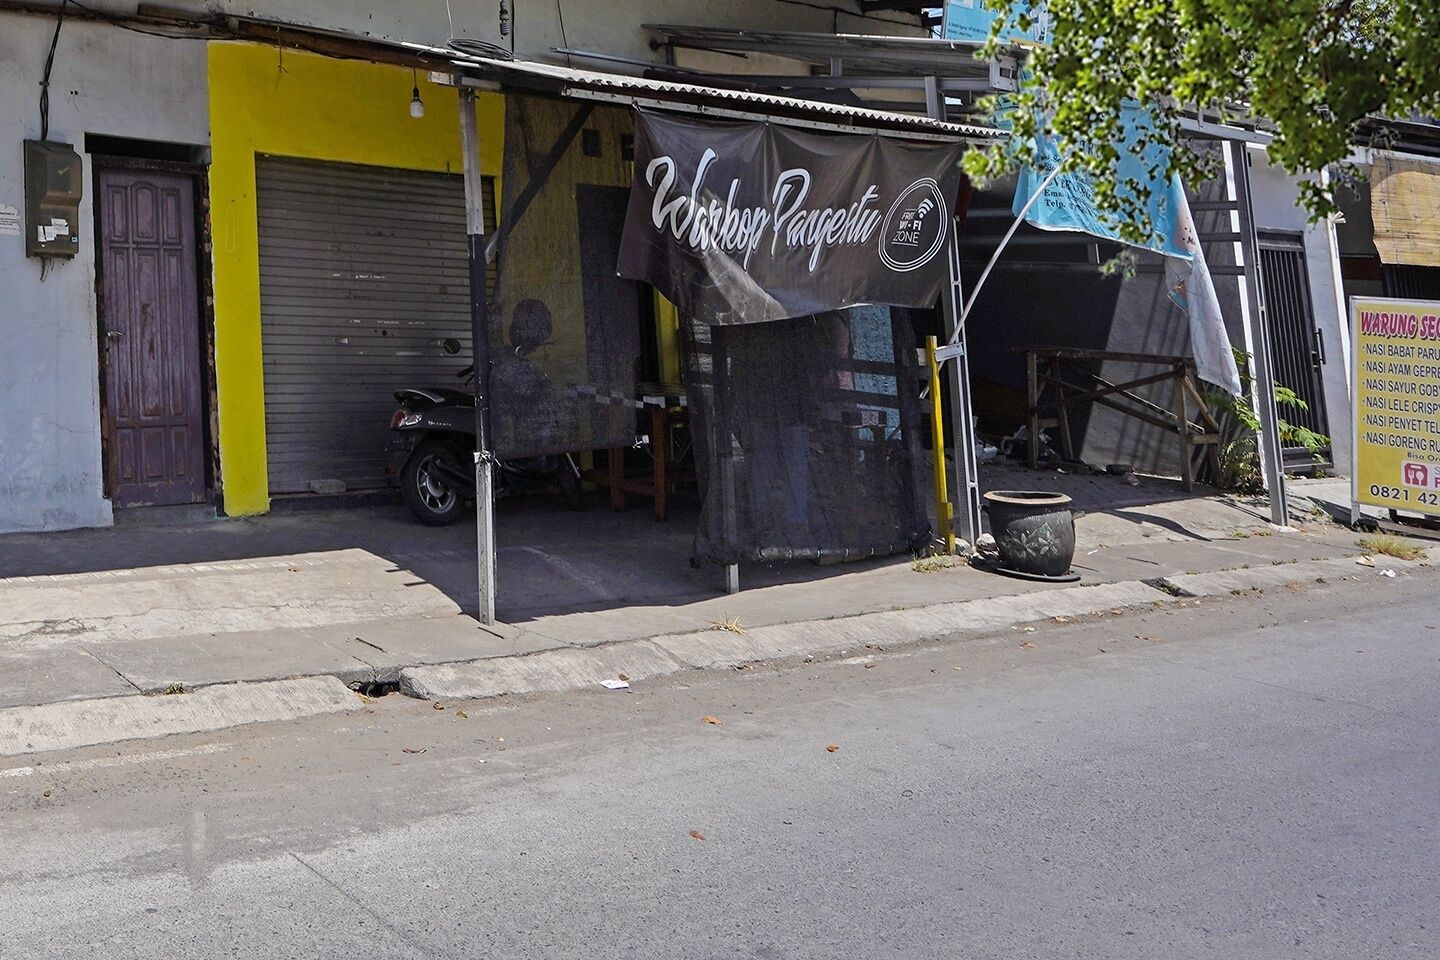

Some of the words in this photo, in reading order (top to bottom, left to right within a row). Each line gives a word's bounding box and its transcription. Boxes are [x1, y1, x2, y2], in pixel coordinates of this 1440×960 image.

[646, 148, 771, 271] Warkop
[771, 168, 882, 273] Pangestu
[892, 230, 920, 244] ZONE
[1361, 311, 1418, 339] WARUNG
[1366, 343, 1386, 356] NASI
[1388, 344, 1415, 358] BABAT
[1366, 361, 1386, 374] NASI
[1388, 363, 1411, 376] AYAM
[1366, 378, 1386, 391] NASI
[1388, 380, 1417, 394] SAYUR
[1419, 383, 1440, 397] GOB
[1366, 396, 1386, 409] NASI
[1388, 398, 1410, 412] LELE
[1366, 414, 1386, 427] NASI
[1388, 416, 1422, 432] PENYET
[1366, 431, 1387, 445] NASI
[1388, 434, 1427, 451] GORENG
[1407, 451, 1425, 460] Bisa
[1370, 484, 1409, 501] 0821
[1417, 492, 1438, 506] 42
